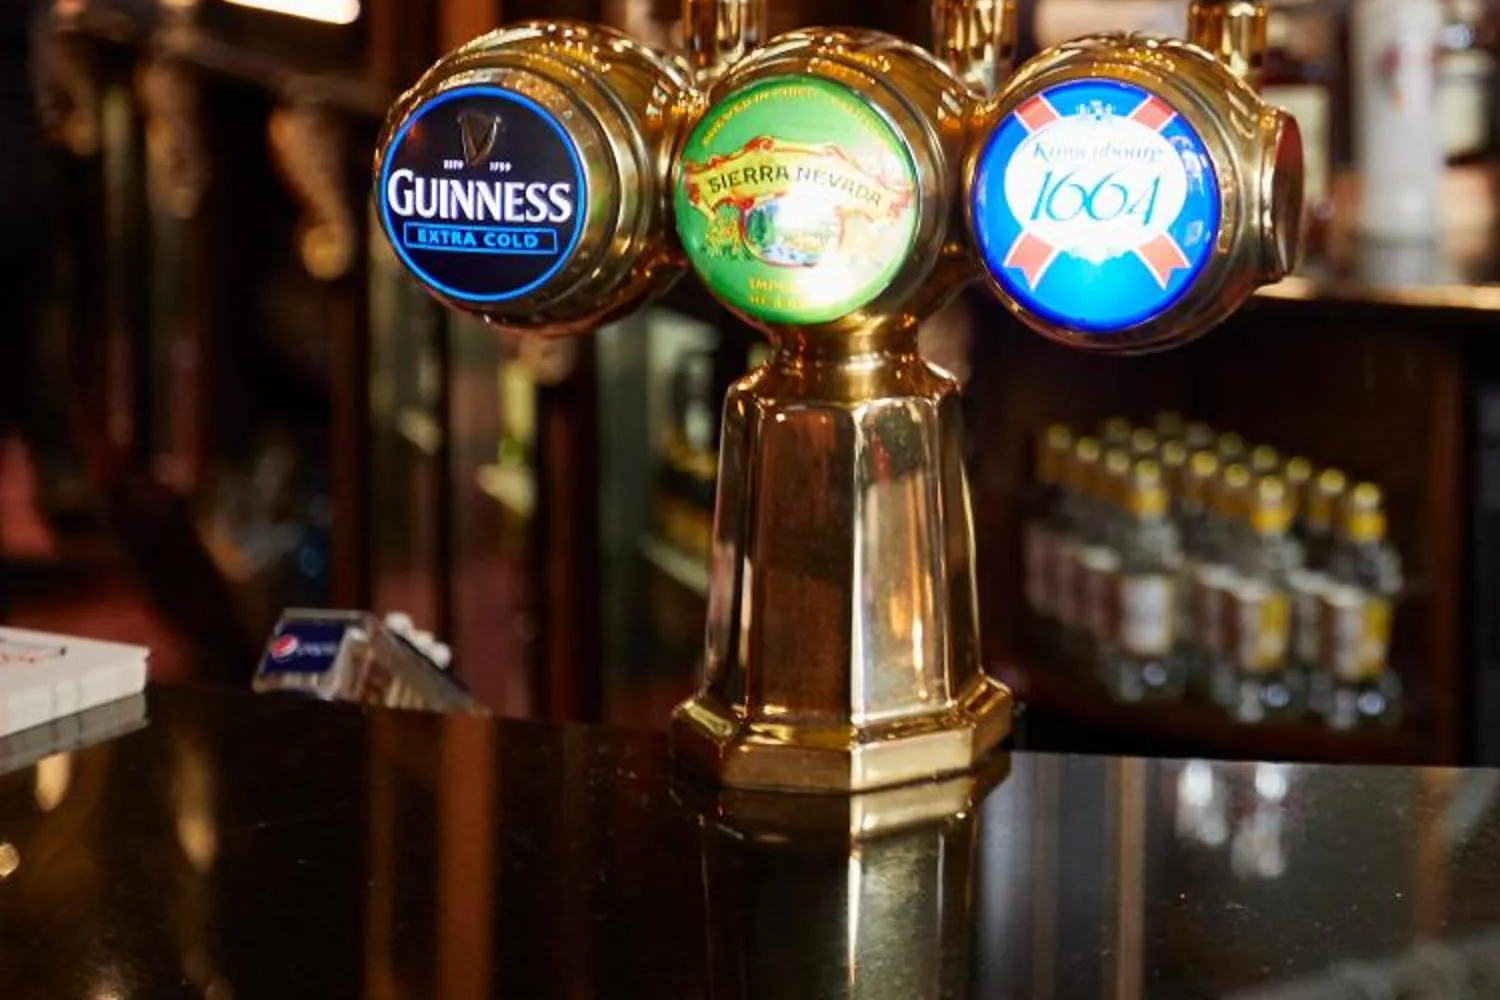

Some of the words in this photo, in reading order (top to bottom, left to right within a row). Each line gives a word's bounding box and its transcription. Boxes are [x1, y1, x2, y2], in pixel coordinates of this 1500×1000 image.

[387, 167, 573, 224] GUINNESS
[707, 165, 790, 195] SIERRA
[796, 166, 882, 207] NEVADA
[1029, 168, 1163, 227] 1664
[417, 229, 477, 247] EXTRA
[483, 231, 539, 249] COLD
